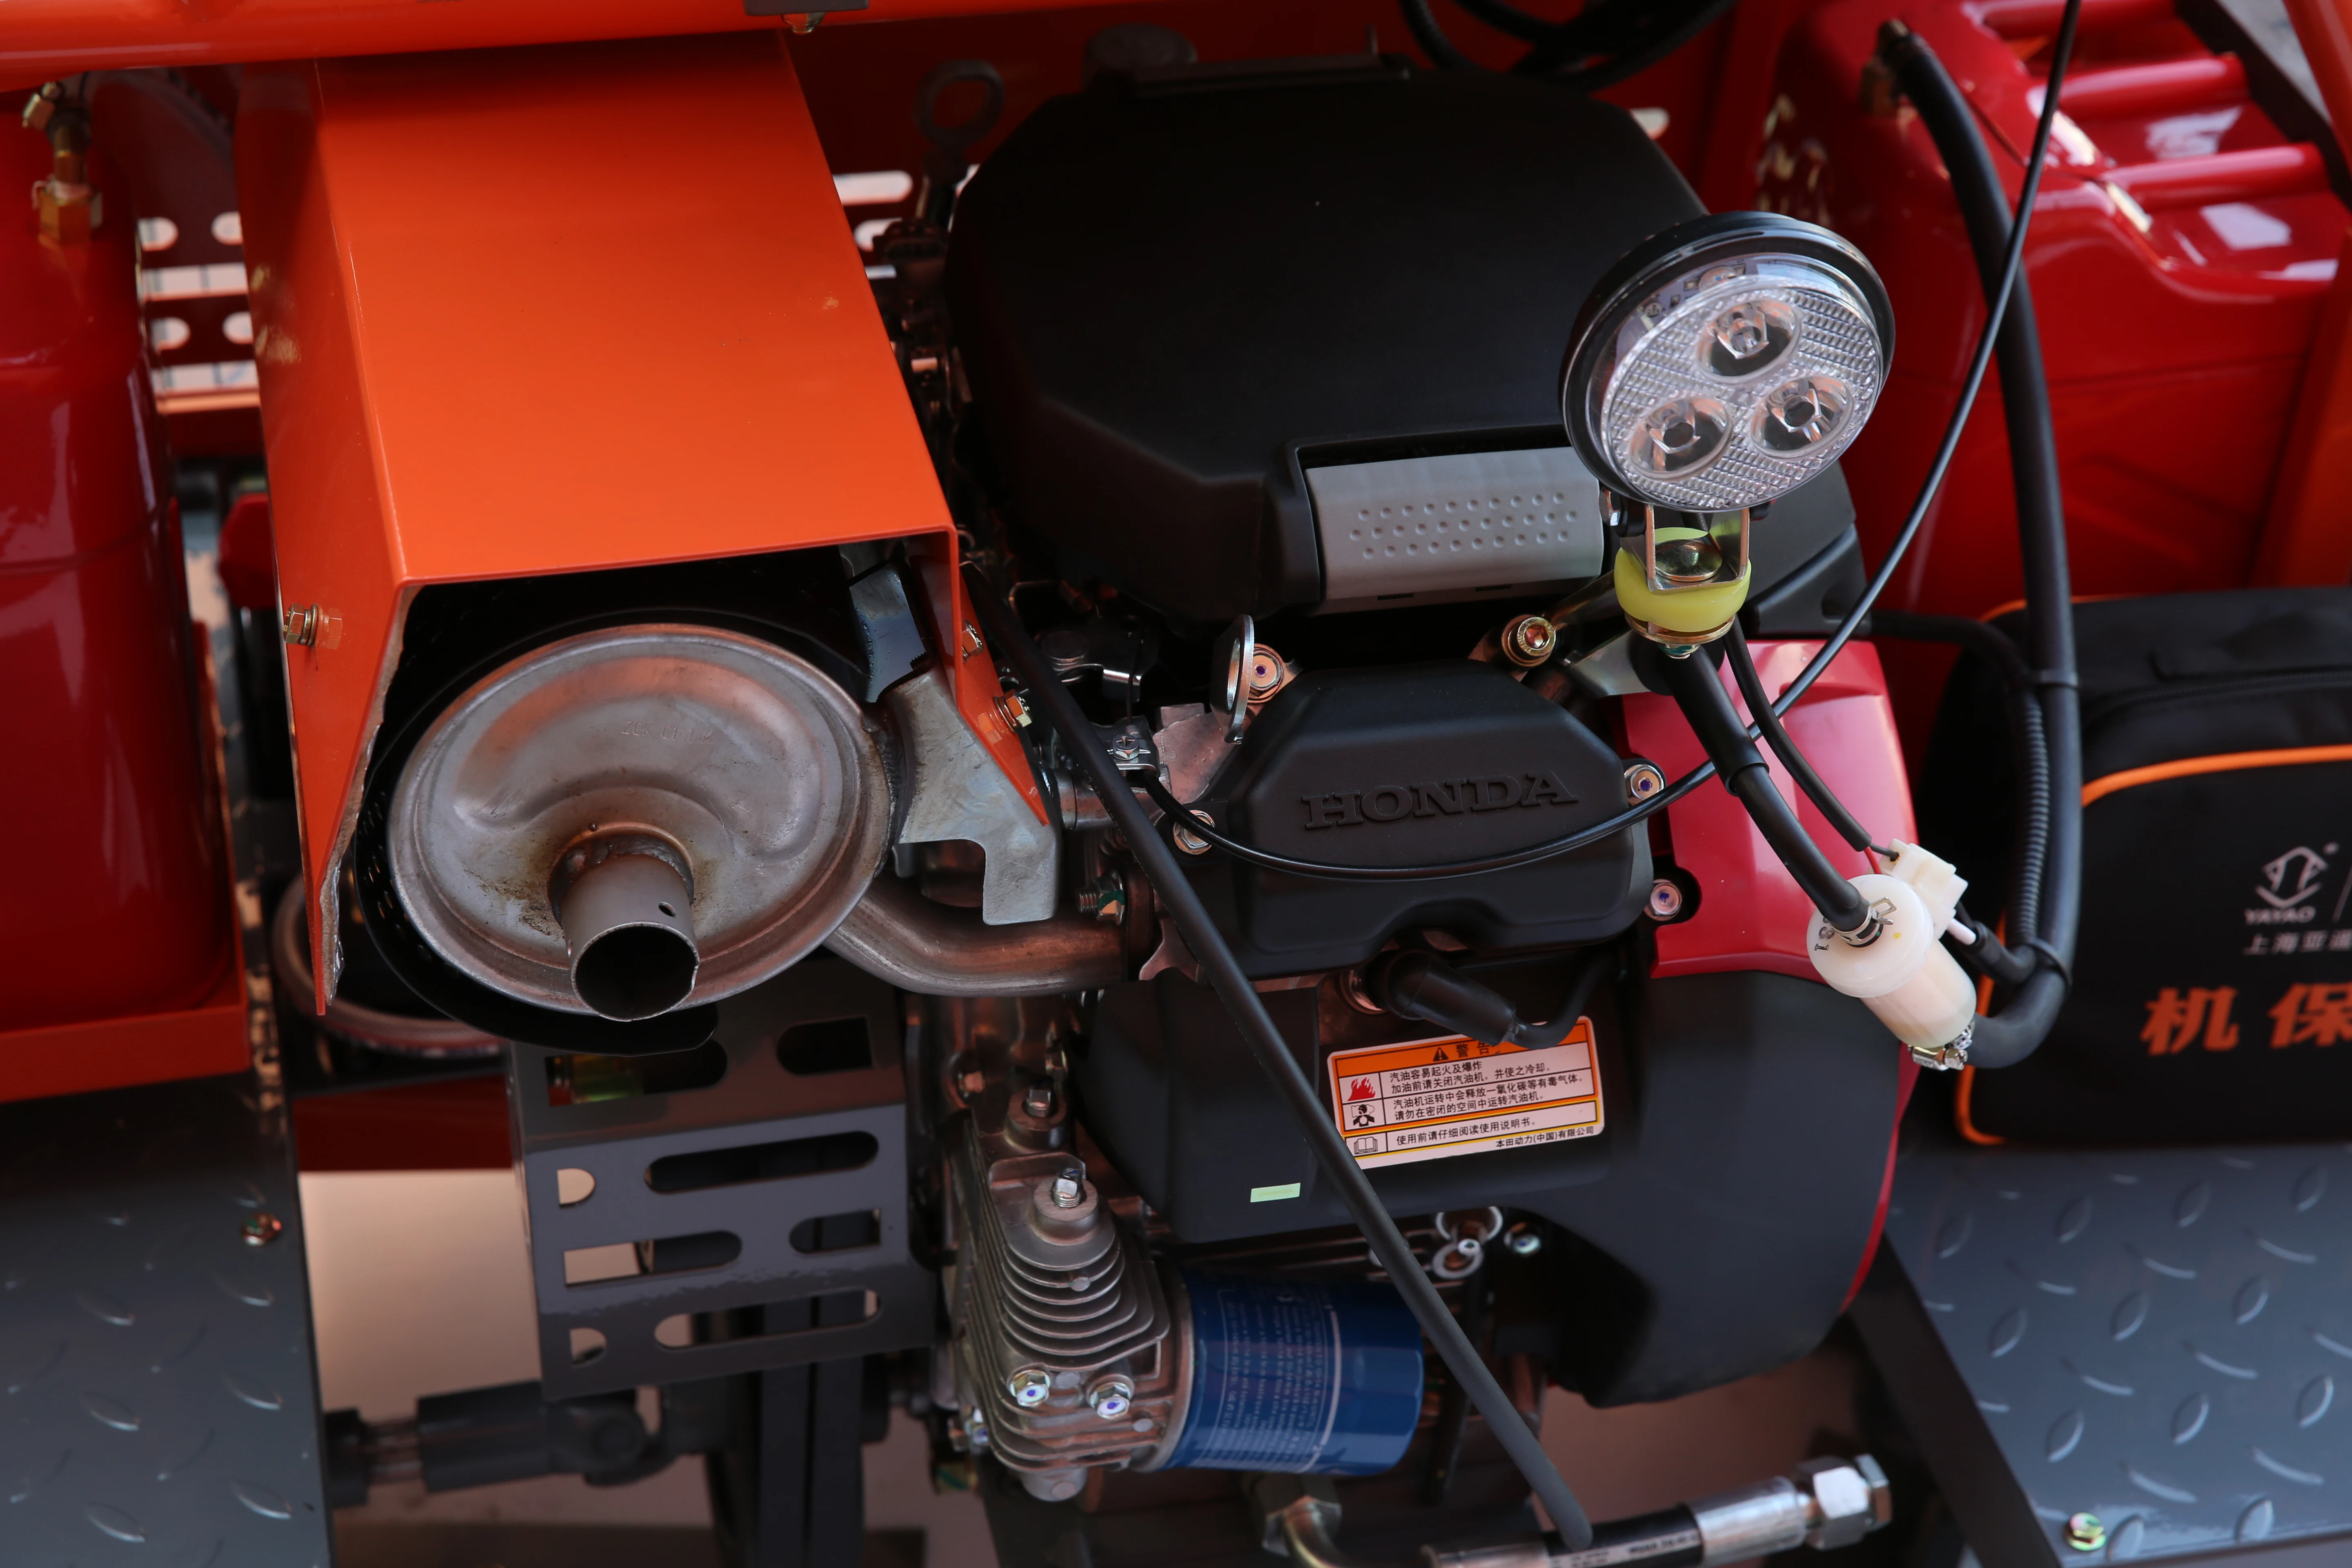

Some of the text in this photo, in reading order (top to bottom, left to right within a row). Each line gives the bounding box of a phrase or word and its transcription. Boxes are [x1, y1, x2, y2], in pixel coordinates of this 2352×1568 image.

[1301, 771, 1579, 830] HONDA
[1456, 1042, 1490, 1058] 警告
[1390, 1060, 1482, 1083] 汽油容易起火及爆炸
[1496, 1126, 1594, 1148] 本田动力(中国)有限公司
